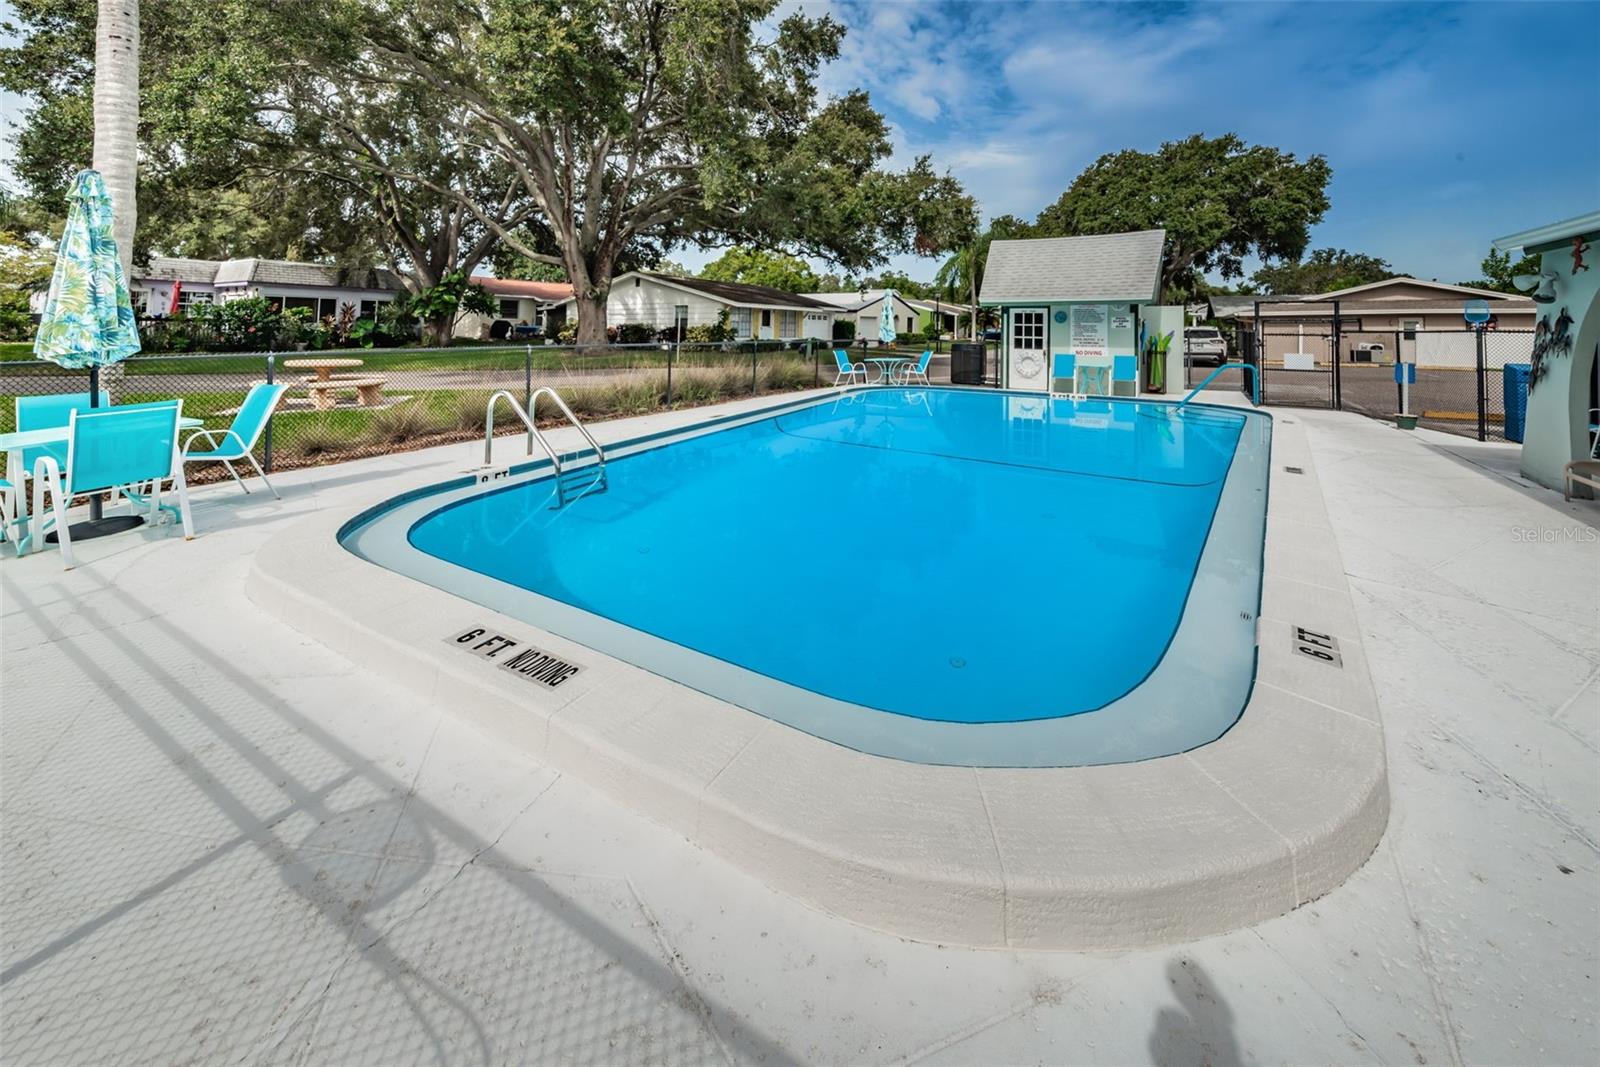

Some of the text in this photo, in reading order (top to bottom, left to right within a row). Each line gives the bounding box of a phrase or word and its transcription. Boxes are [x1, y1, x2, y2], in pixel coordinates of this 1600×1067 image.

[456, 628, 517, 657] 6 FT.
[1298, 646, 1334, 661] 6
[518, 655, 579, 687] DIVING
